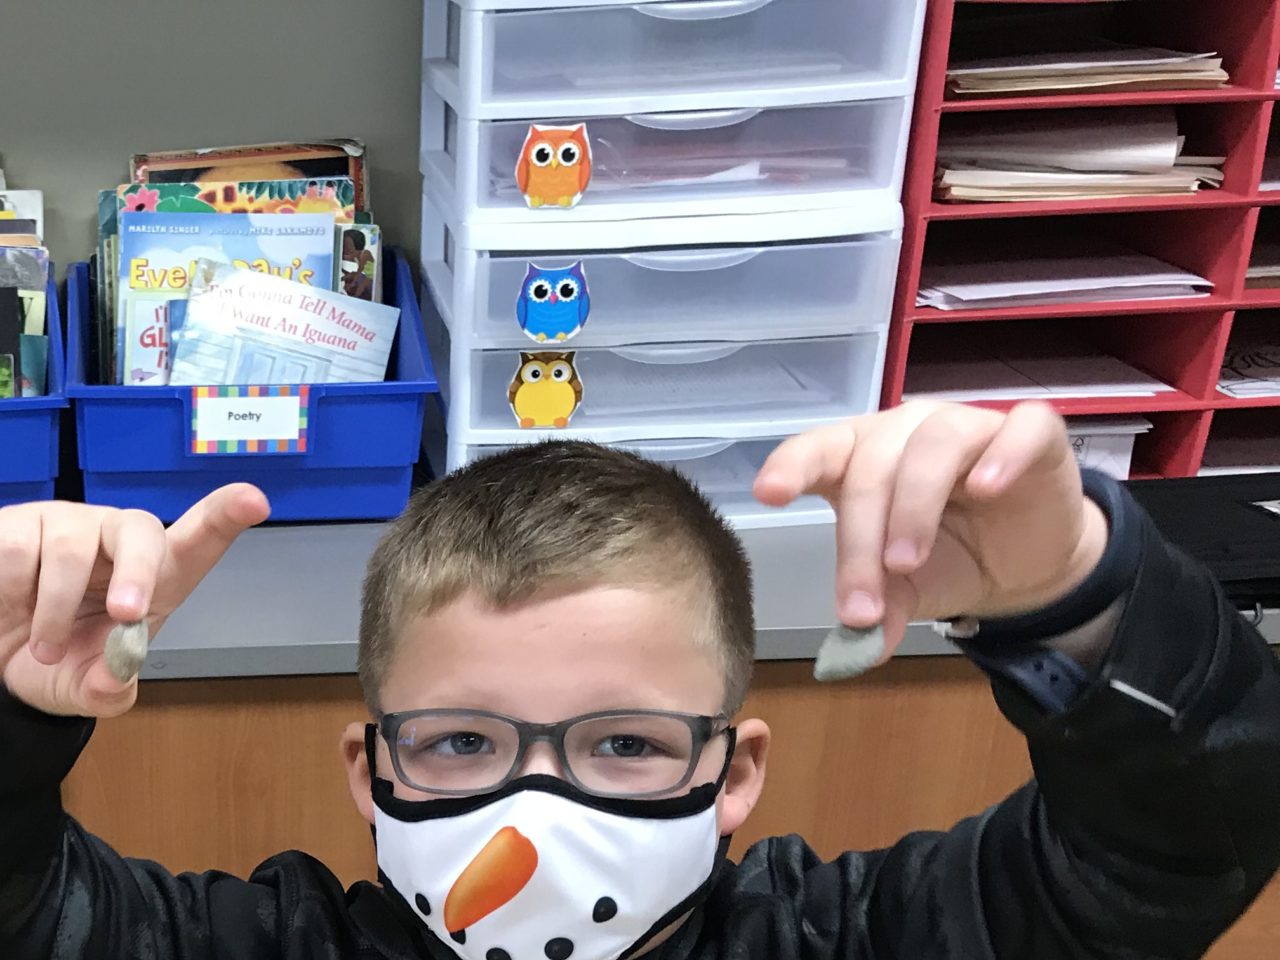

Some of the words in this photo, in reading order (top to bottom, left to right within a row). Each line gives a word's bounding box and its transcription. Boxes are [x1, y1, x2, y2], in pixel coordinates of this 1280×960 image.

[128, 225, 167, 233] MARILYN
[129, 258, 198, 290] Eve
[232, 305, 272, 328] Want
[273, 317, 298, 336] An
[302, 322, 358, 351] Iguana
[298, 294, 326, 317] Tell
[327, 305, 377, 344] Mama
[227, 411, 262, 422] Poetry
